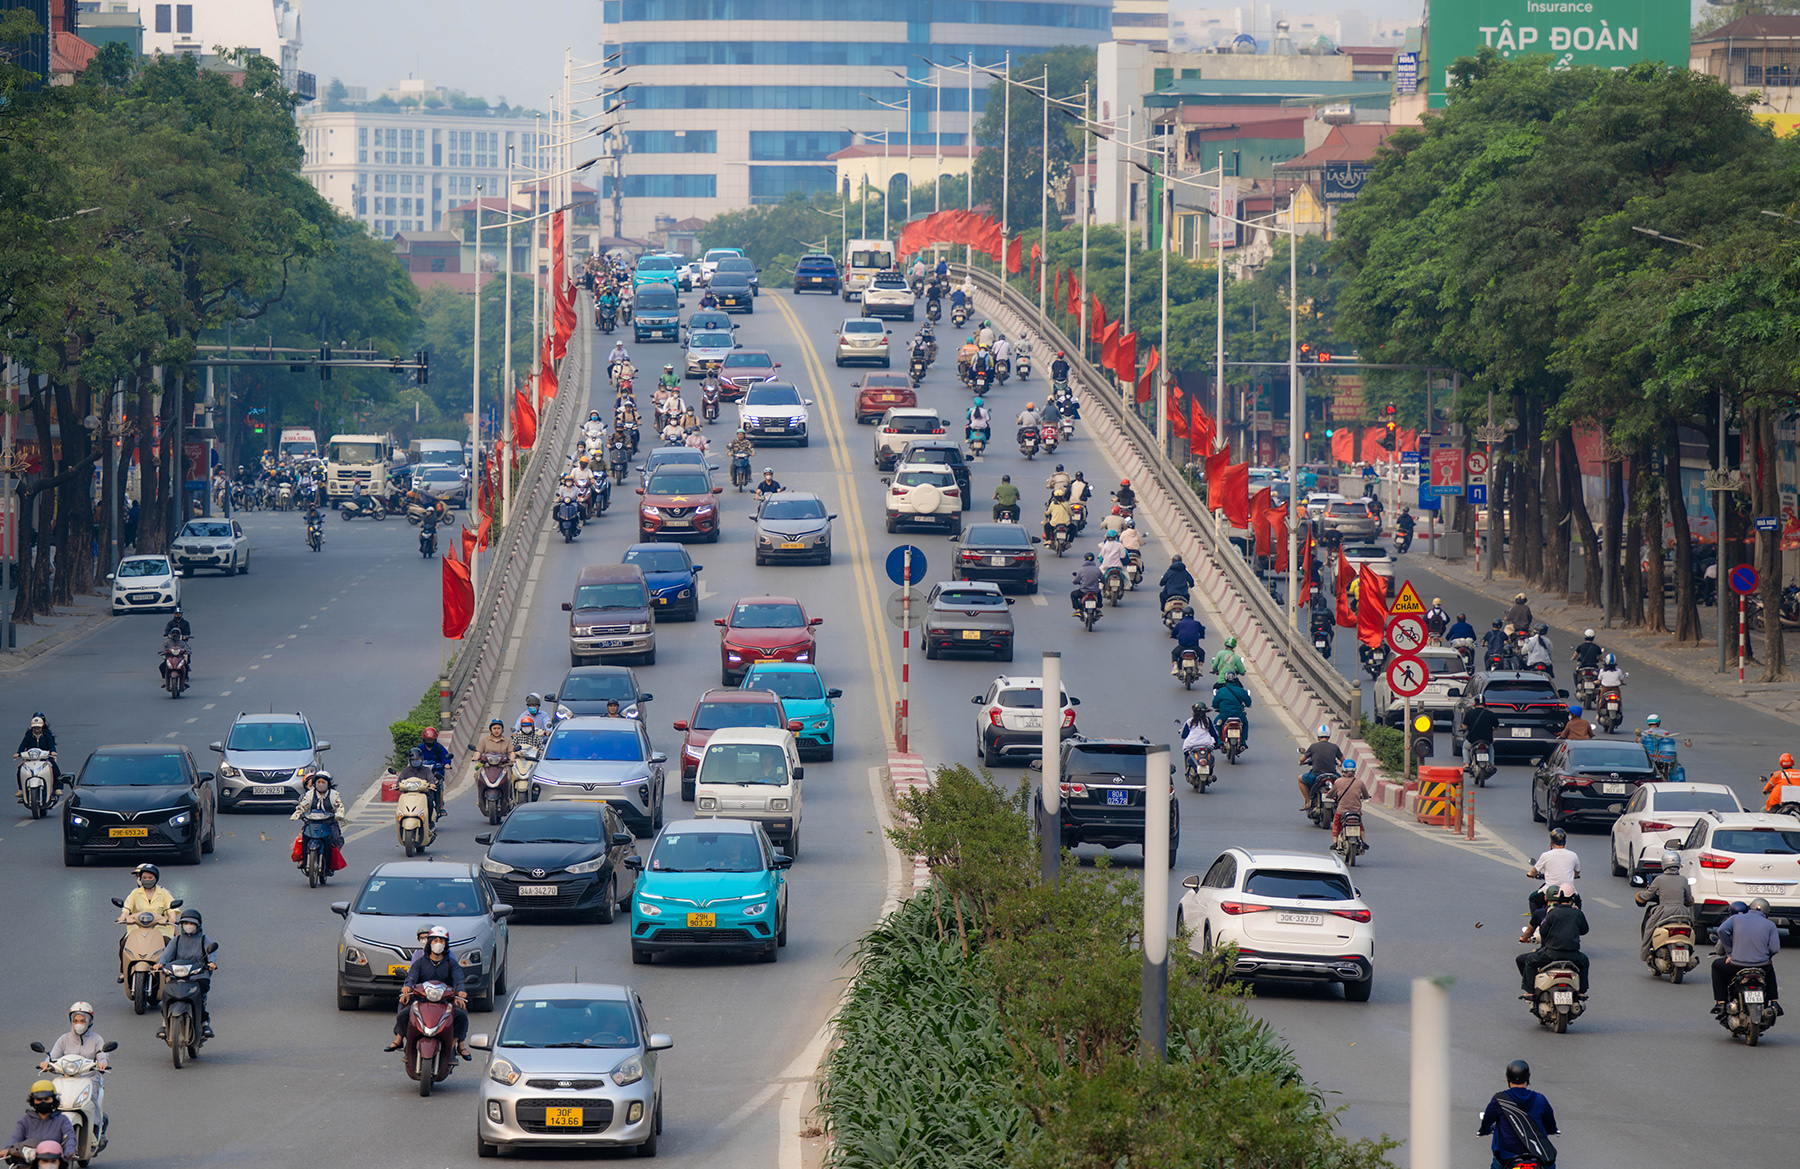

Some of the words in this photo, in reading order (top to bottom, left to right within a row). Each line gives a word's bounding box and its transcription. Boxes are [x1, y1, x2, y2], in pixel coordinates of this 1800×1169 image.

[1527, 1, 1593, 13] Insurance
[1479, 19, 1538, 57] TẬP
[1549, 20, 1638, 50] ĐOÀN
[1396, 602, 1419, 611] CHẬM
[1280, 914, 1319, 923] 30K-327.57
[551, 1117, 579, 1125] 143.66
